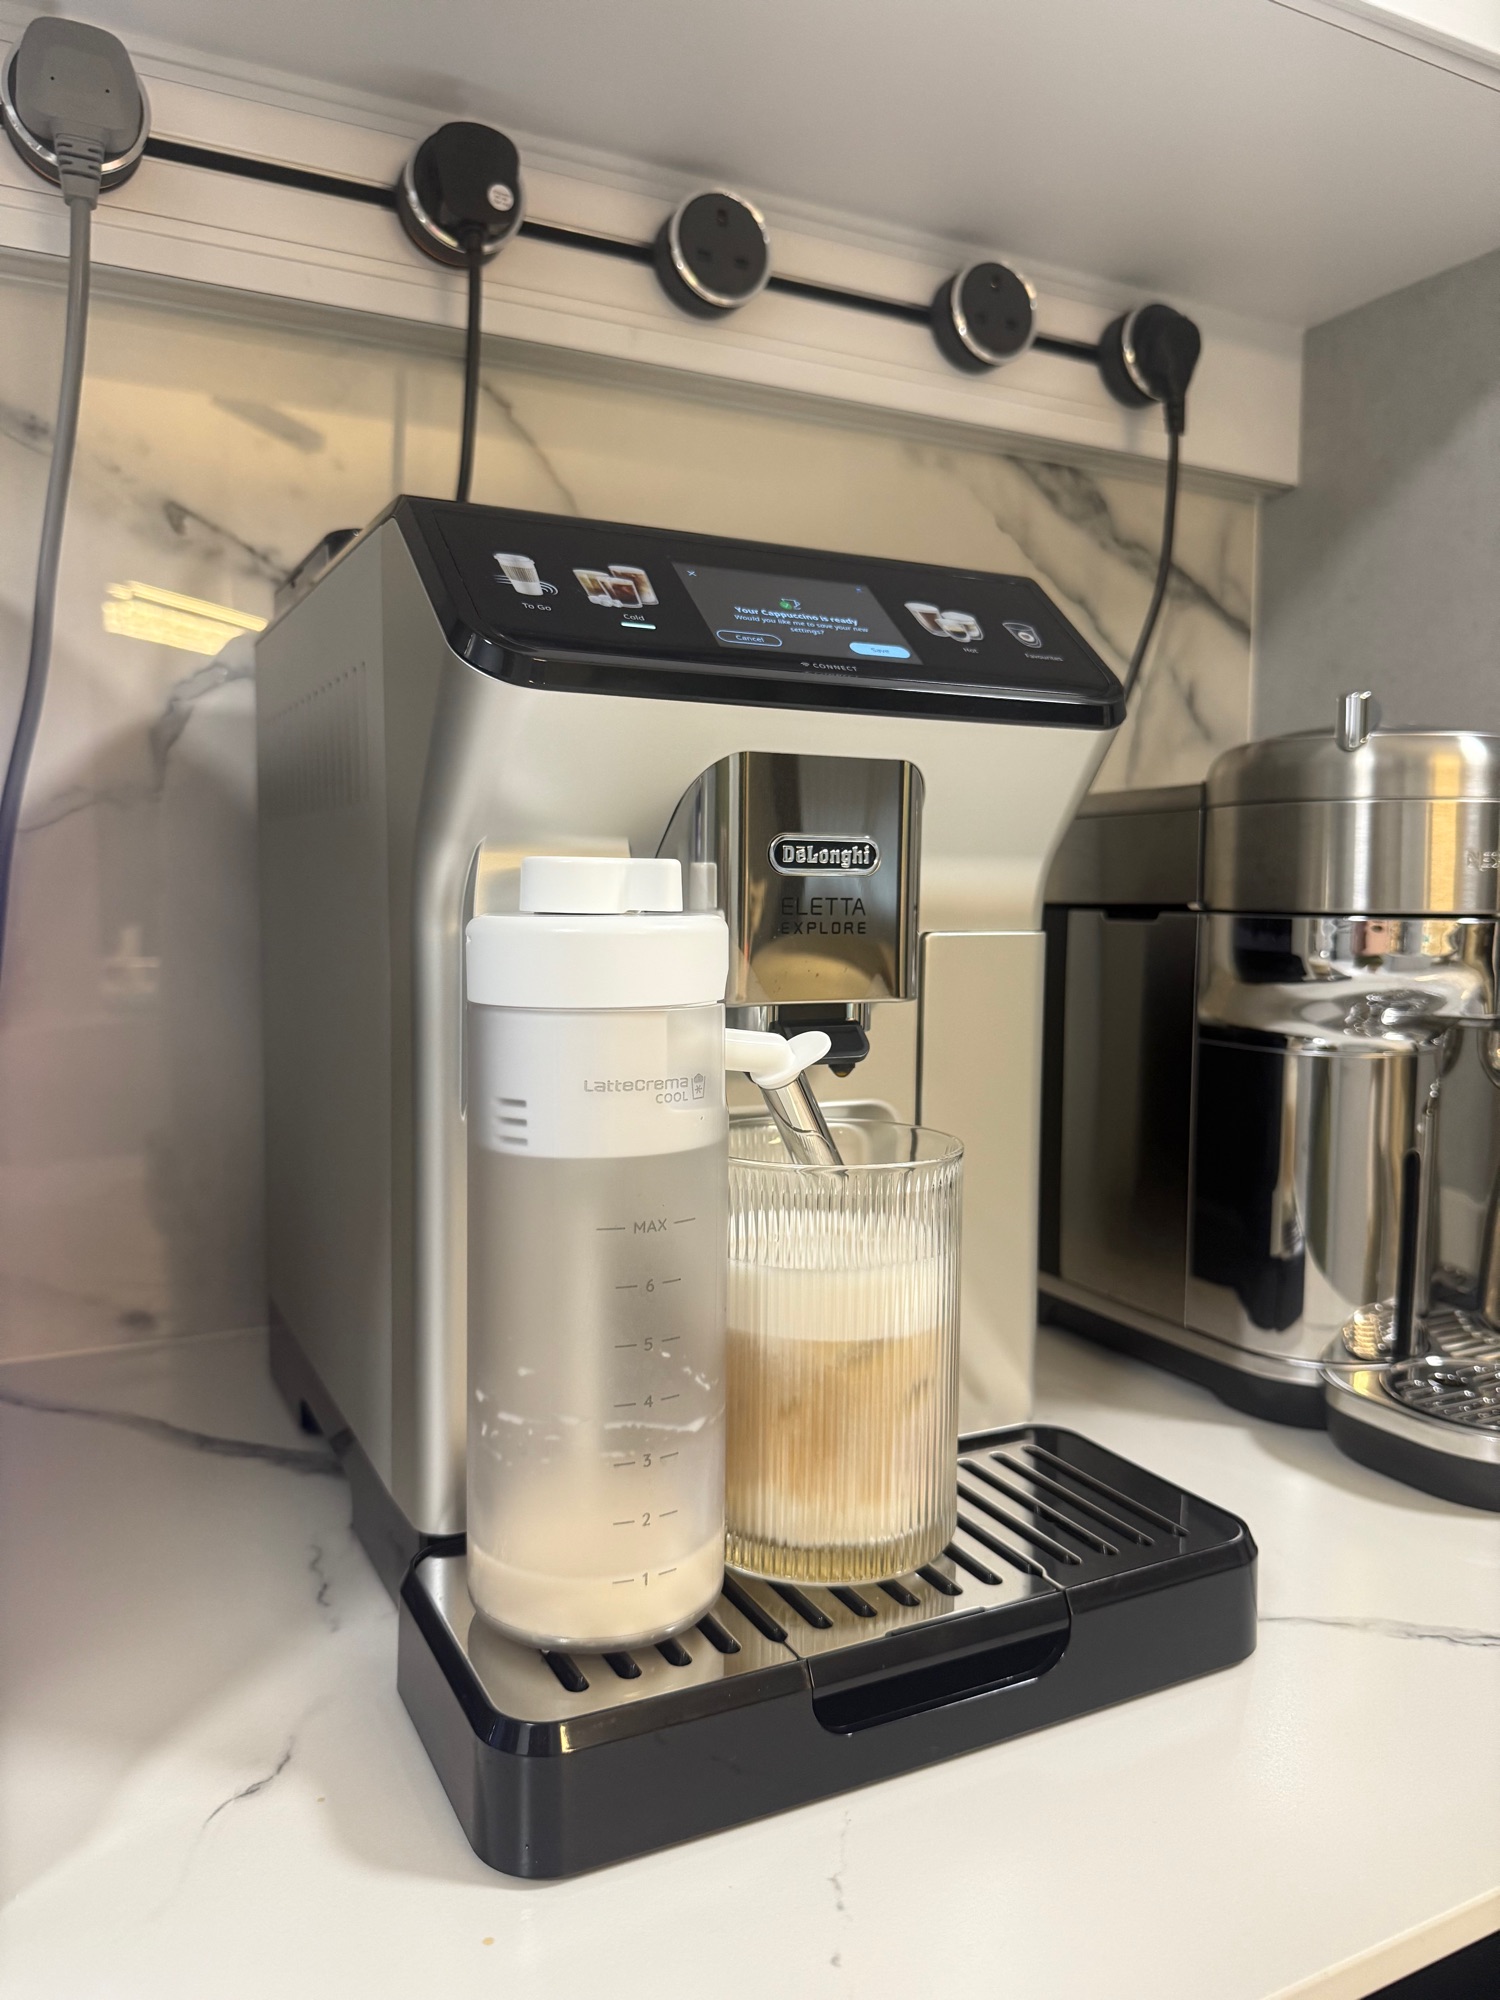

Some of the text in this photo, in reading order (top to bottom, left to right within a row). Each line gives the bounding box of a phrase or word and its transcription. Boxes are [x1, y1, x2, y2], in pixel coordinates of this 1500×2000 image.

[522, 602, 536, 610] To
[623, 613, 645, 622] Cold
[734, 606, 758, 615] Your
[761, 609, 818, 621] Cappuccino
[830, 617, 858, 626] ready
[734, 614, 760, 622] Would
[790, 627, 825, 635] settings?
[735, 635, 765, 643] Cancel
[812, 663, 858, 672] CONNECT
[781, 897, 866, 916] ELETTA
[781, 922, 866, 934] EXPLORE
[584, 1077, 689, 1093] LatteCrema
[655, 1092, 689, 1104] COOL
[633, 1218, 668, 1235] MAX
[645, 1278, 655, 1293] 6
[644, 1337, 653, 1351] 5
[643, 1395, 654, 1408] 4
[643, 1454, 652, 1468] 3
[642, 1512, 651, 1527] 2
[642, 1572, 649, 1586] 1
